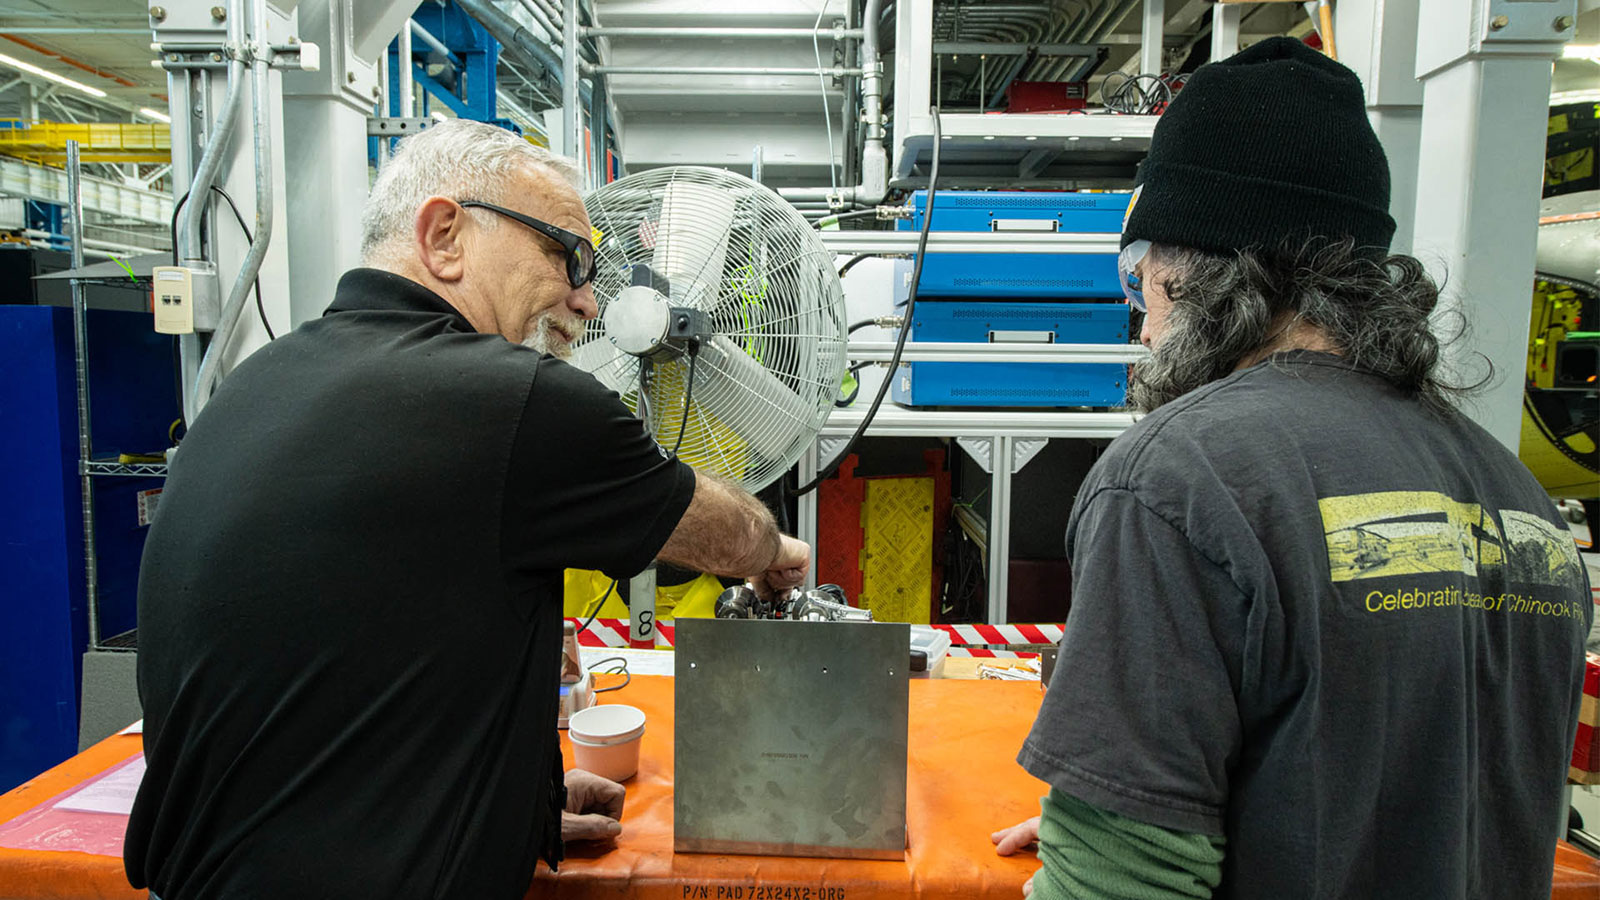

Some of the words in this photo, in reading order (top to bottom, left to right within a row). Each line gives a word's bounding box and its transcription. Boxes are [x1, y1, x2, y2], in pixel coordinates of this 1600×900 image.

[1365, 585, 1461, 613] Celebratin
[1482, 593, 1507, 612] of
[1507, 593, 1571, 618] Chinook
[638, 610, 653, 637] 8
[717, 886, 743, 900] PAD
[748, 886, 845, 900] 72X24X2-ORG
